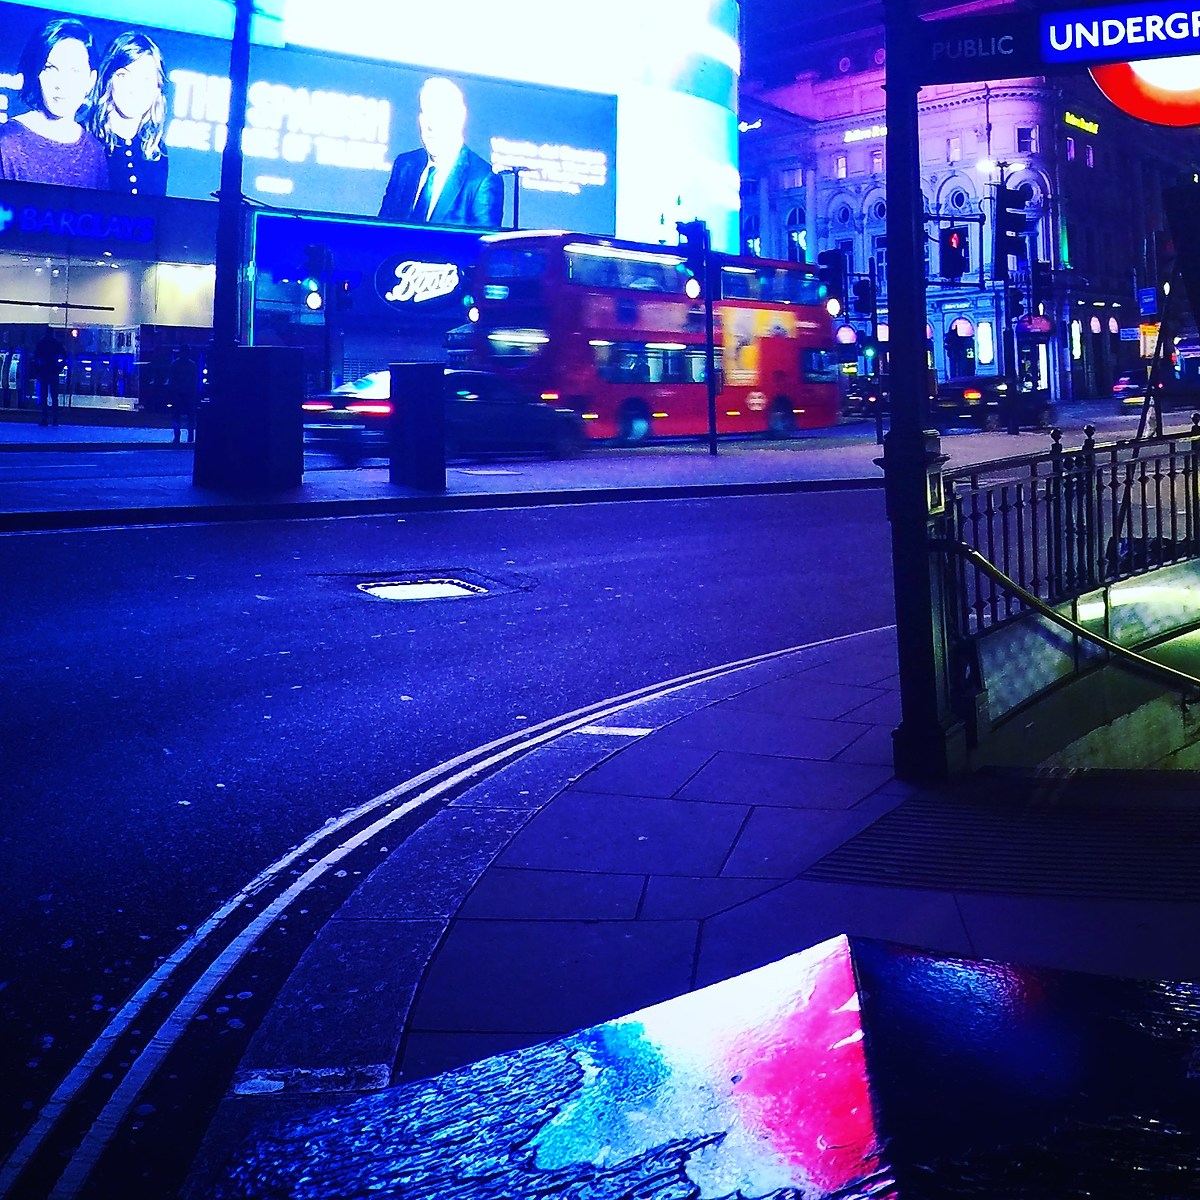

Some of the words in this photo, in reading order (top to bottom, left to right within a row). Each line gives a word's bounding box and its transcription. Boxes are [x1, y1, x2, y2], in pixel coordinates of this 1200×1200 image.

[931, 35, 1014, 61] PUBLIC
[19, 206, 156, 244] BARCLAYS
[385, 261, 459, 302] Boots
